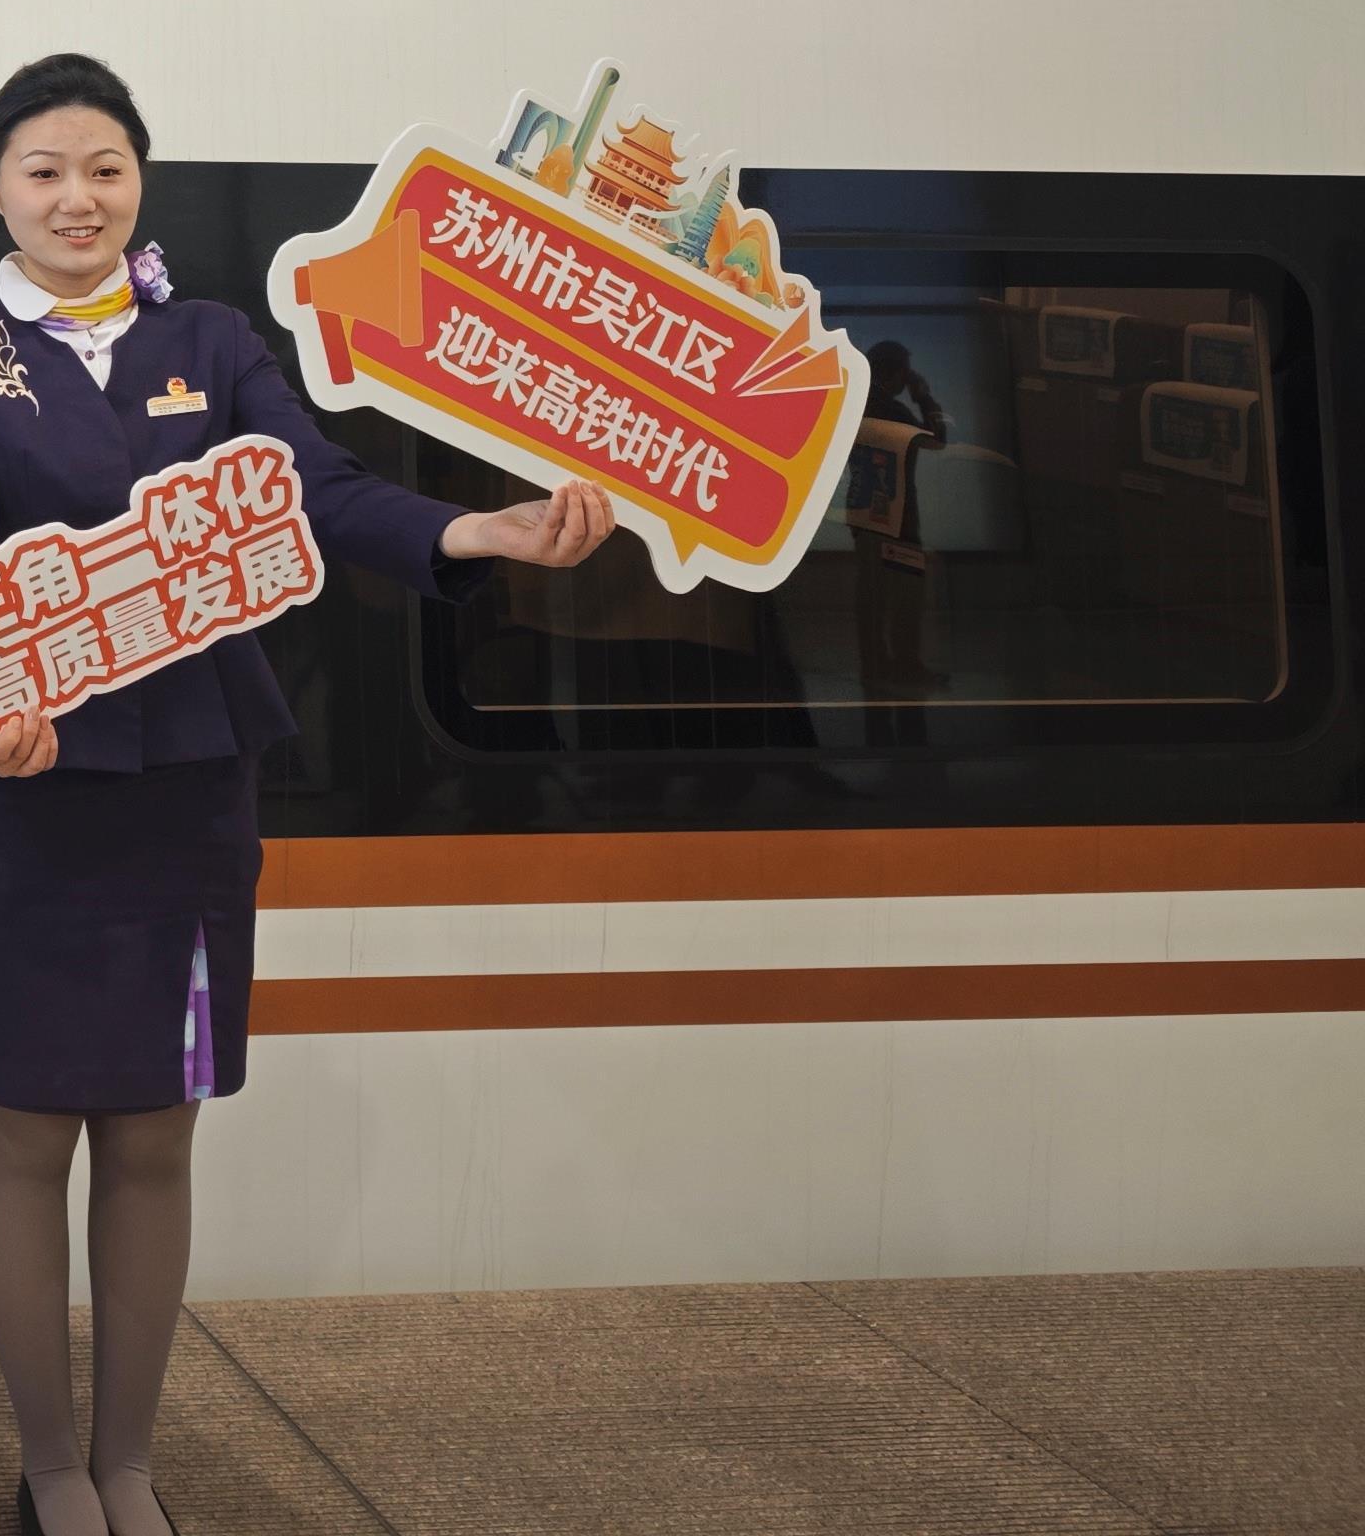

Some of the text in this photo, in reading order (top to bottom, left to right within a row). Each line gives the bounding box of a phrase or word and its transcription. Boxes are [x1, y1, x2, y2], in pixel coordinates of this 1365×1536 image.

[427, 186, 735, 395] 苏州市吴江区
[425, 305, 730, 513] 迎来高铁时代
